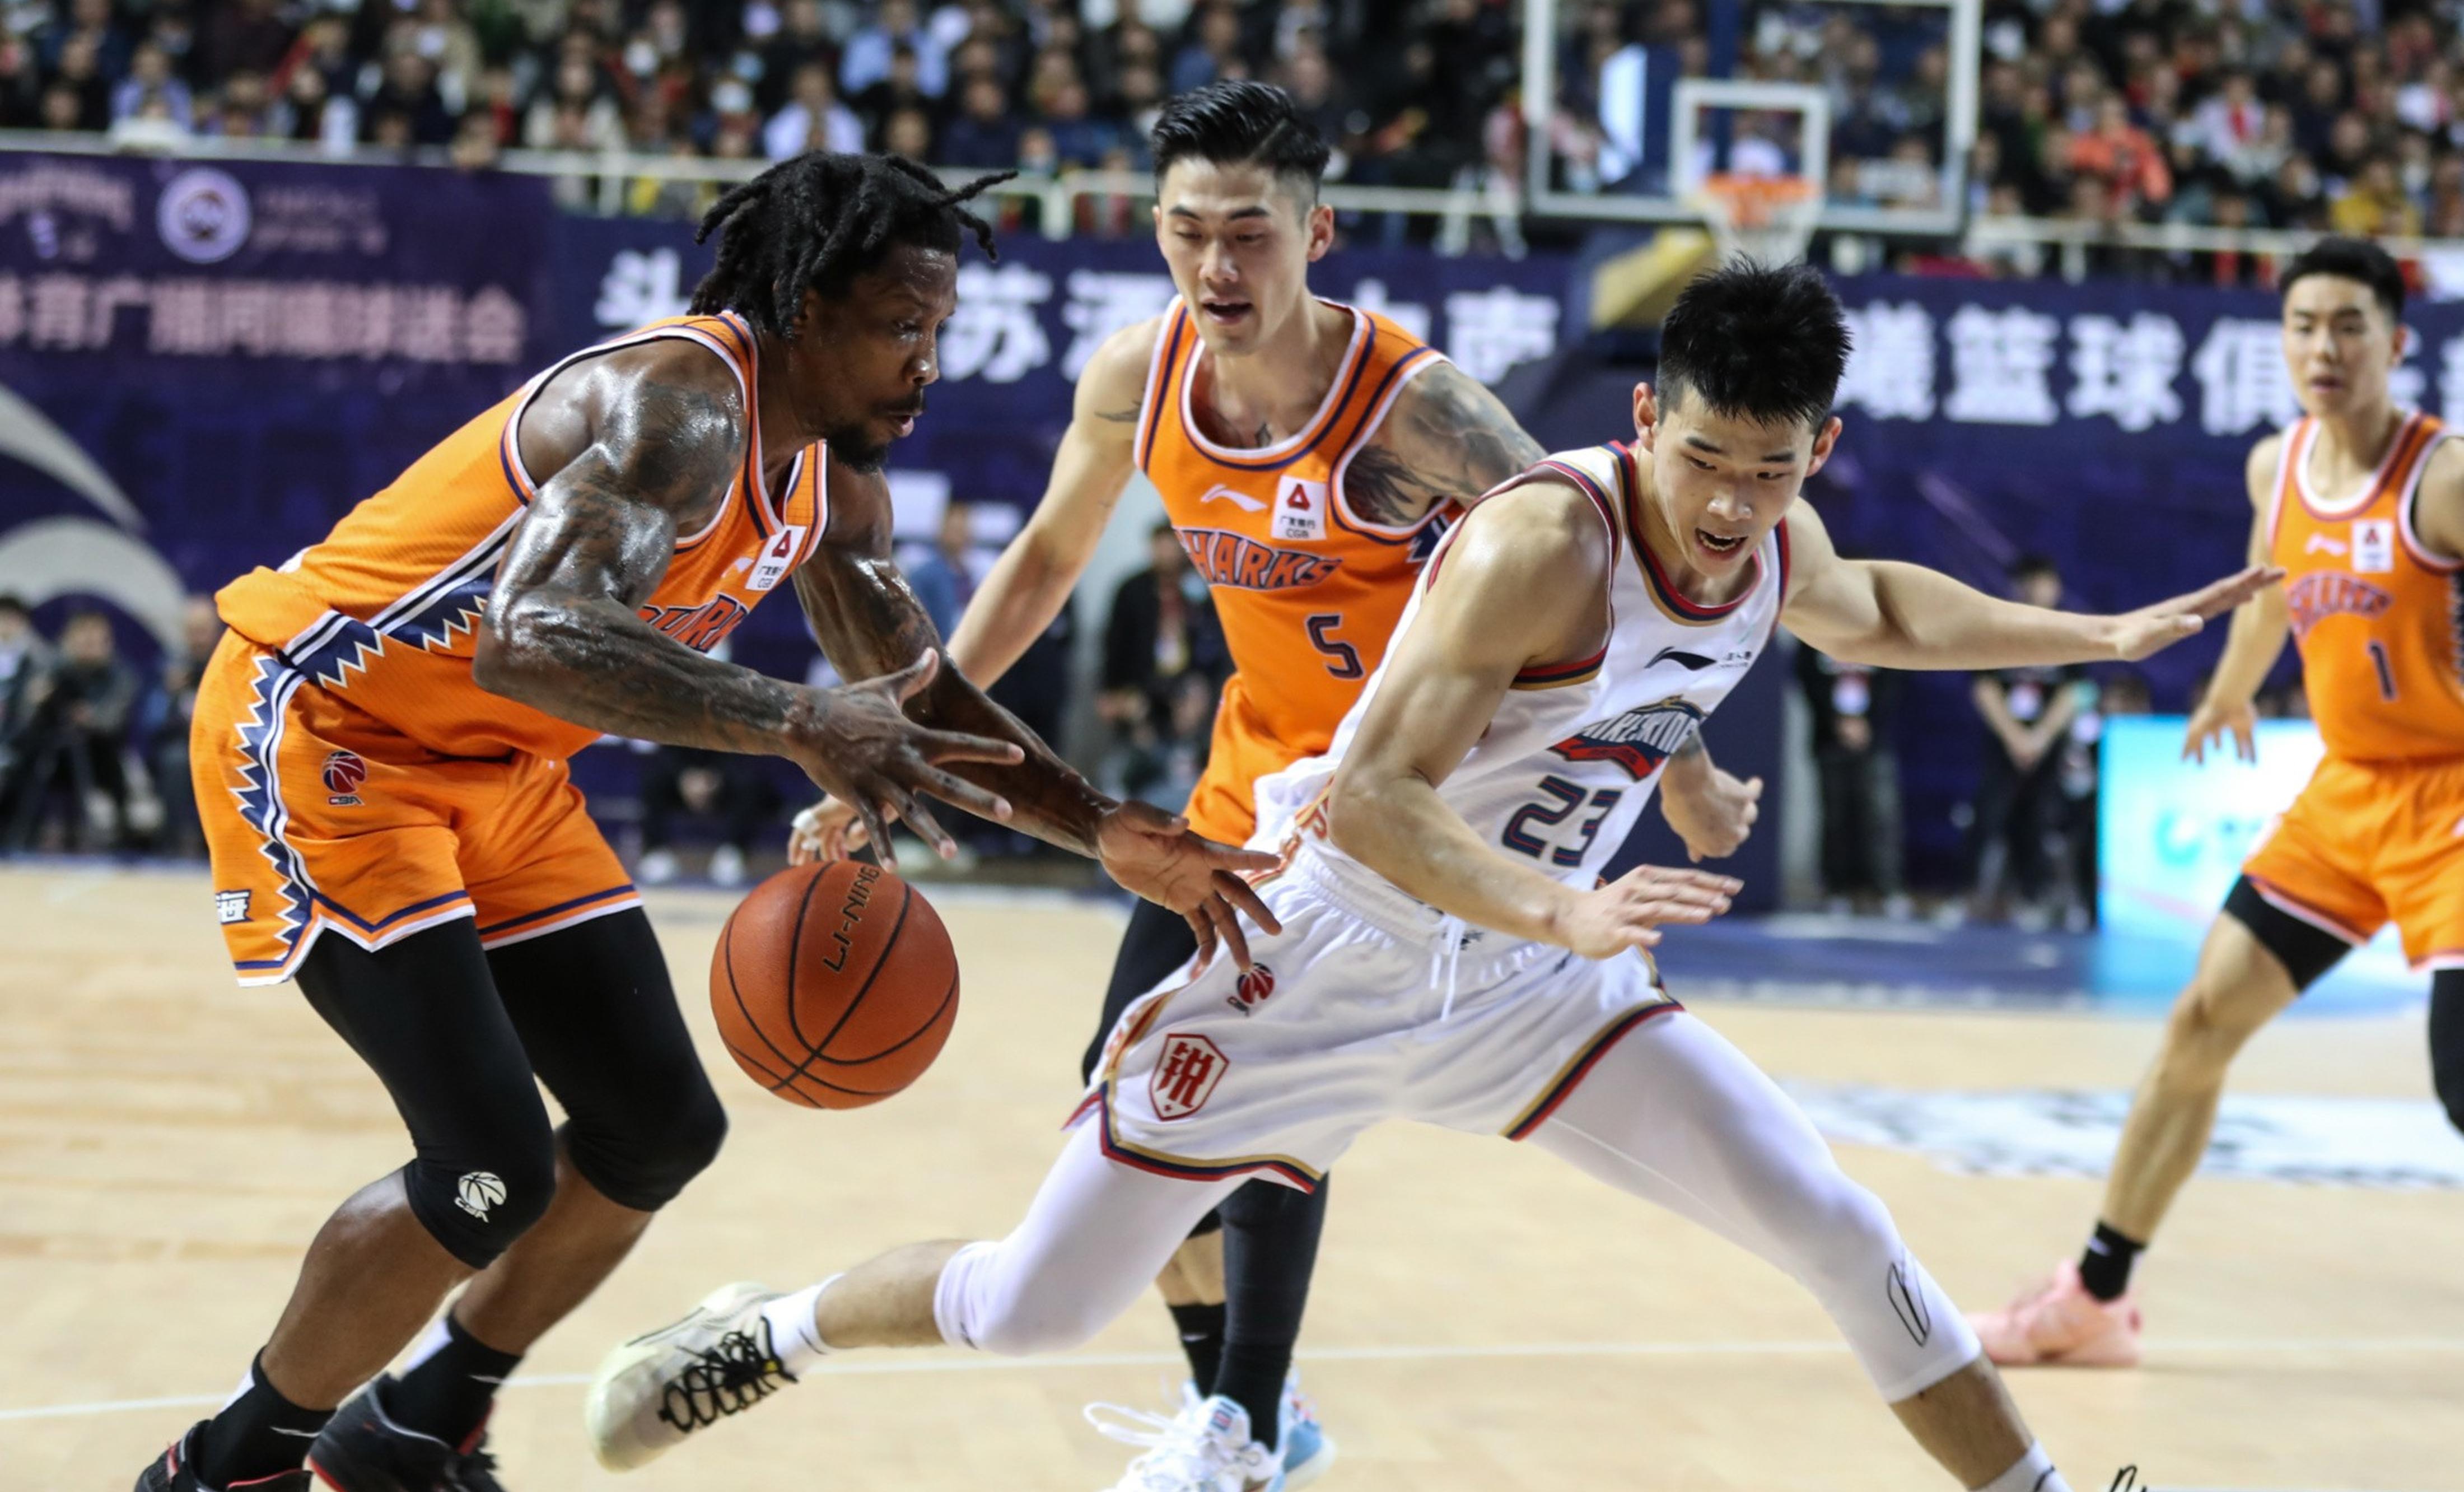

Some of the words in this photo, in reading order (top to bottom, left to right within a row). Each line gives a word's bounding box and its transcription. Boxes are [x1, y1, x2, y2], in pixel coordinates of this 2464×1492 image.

[1174, 529, 1343, 589] HARKS
[1305, 613, 1365, 681] 5
[2368, 640, 2397, 701] 1
[328, 795, 364, 805] CBA
[1501, 775, 1623, 868] 23
[823, 864, 881, 973] LI-NING
